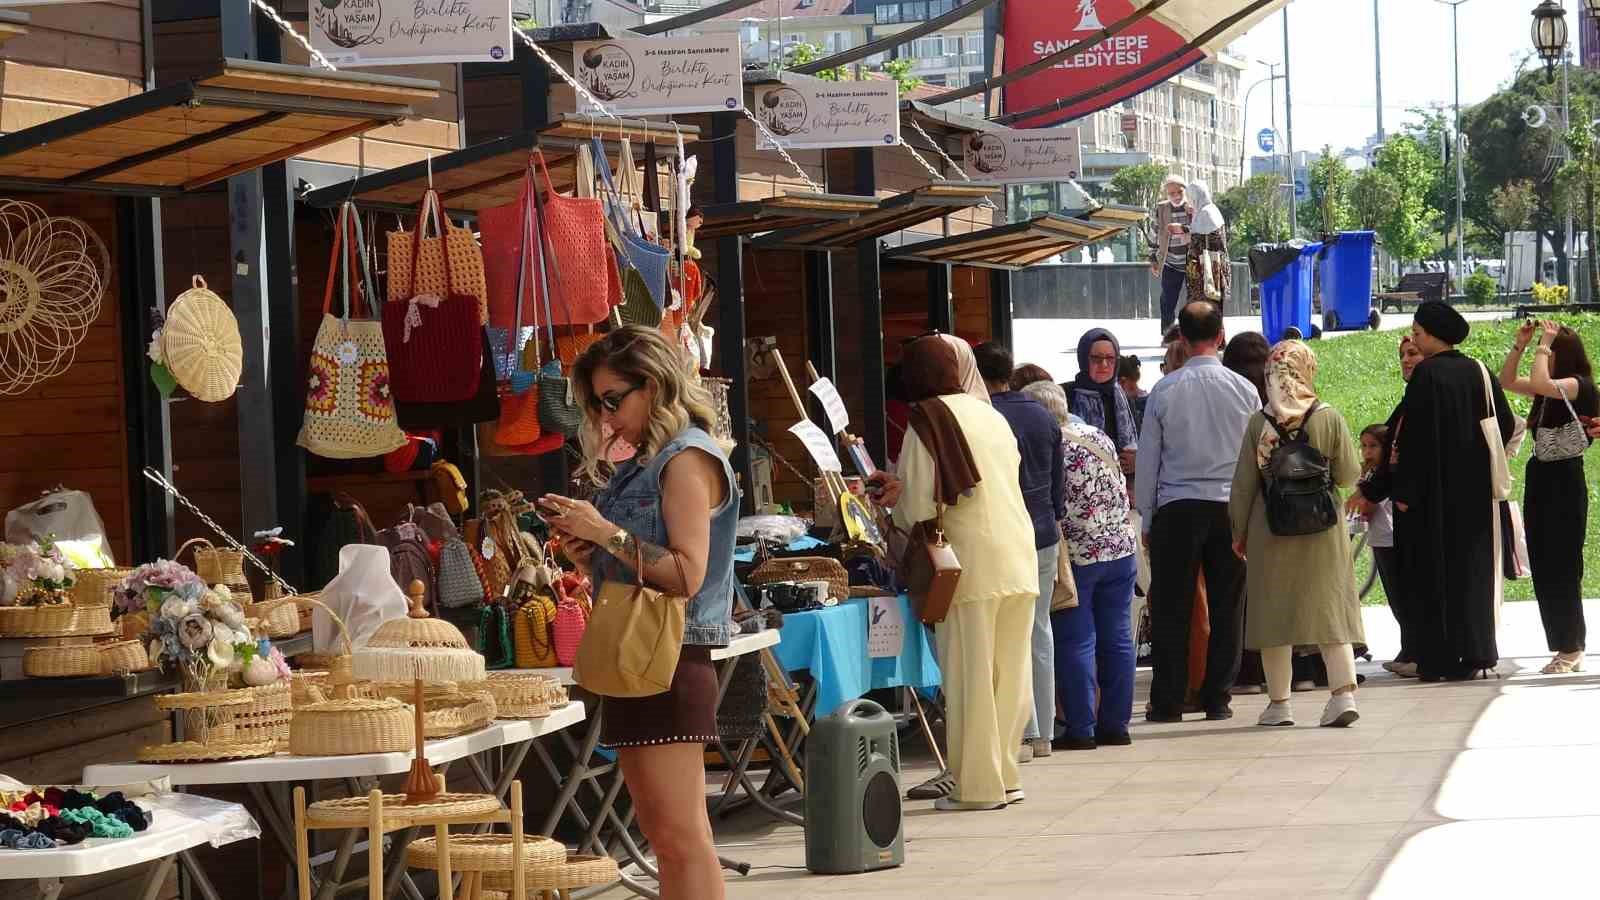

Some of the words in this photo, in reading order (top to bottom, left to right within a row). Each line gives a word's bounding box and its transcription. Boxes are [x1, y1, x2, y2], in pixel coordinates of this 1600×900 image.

[343, 0, 374, 8] KADIN
[414, 0, 470, 19] Birlikte
[344, 14, 375, 24] YAŞAM
[463, 14, 502, 32] Kent
[603, 60, 629, 68] KADIN
[661, 60, 709, 77] Birlikte
[604, 73, 630, 81] YAŞAM
[702, 72, 734, 89] Kent
